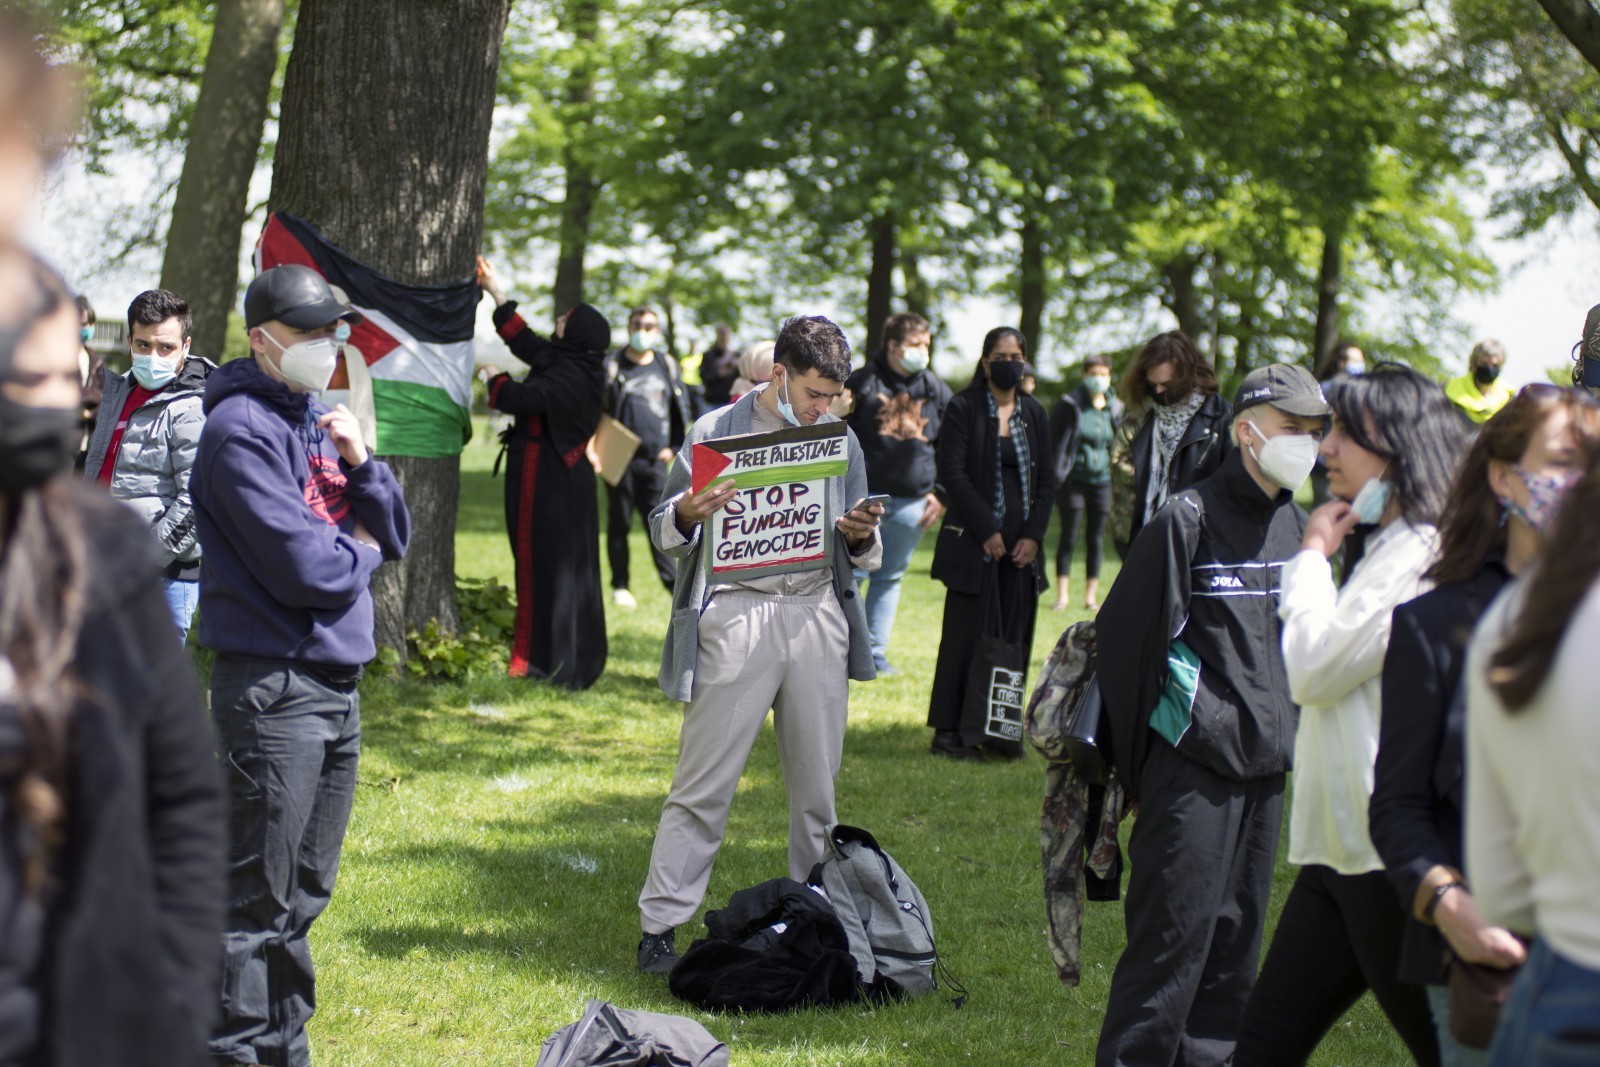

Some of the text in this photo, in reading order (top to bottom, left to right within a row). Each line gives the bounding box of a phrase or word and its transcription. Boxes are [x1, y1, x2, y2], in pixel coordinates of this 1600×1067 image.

[734, 438, 843, 469] FREE PALESTINE
[723, 483, 809, 515] STOP
[721, 503, 822, 540] FUNDING
[716, 529, 822, 561] GENOCIDE
